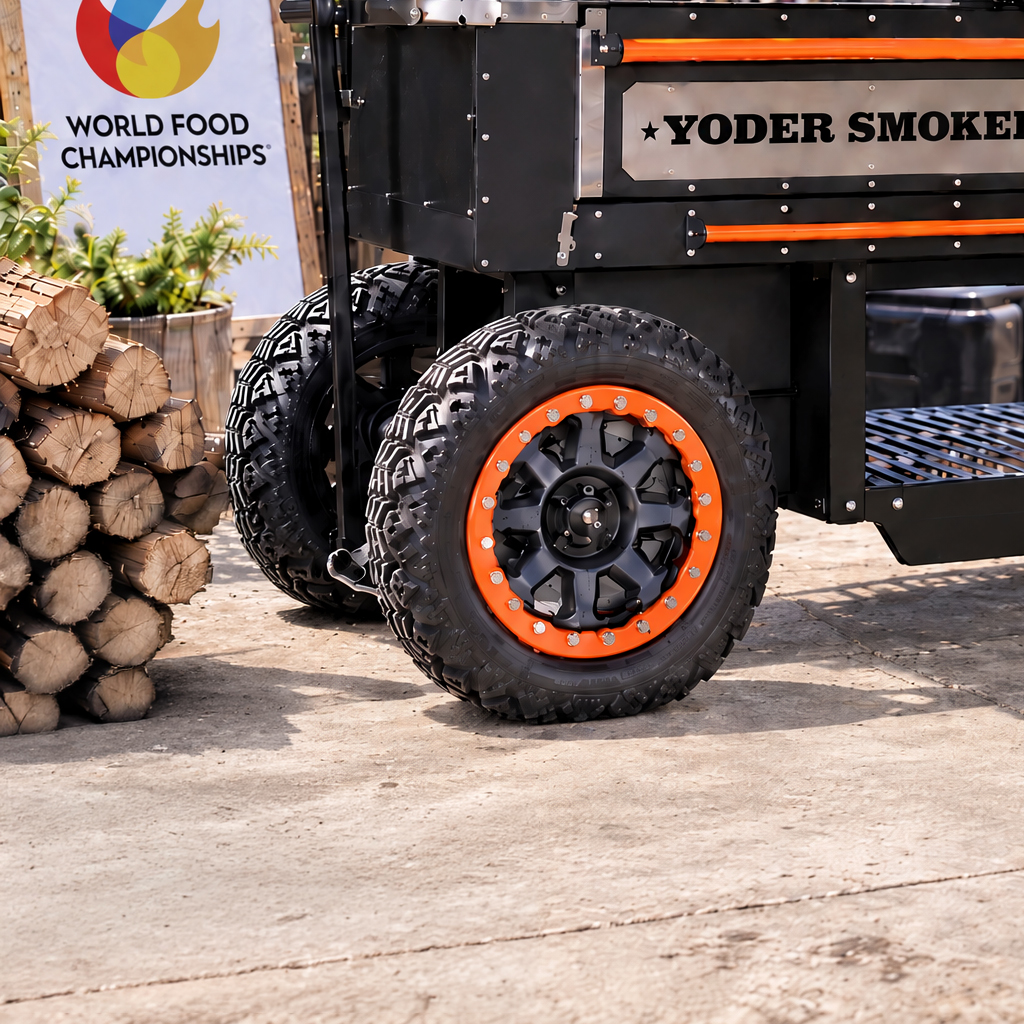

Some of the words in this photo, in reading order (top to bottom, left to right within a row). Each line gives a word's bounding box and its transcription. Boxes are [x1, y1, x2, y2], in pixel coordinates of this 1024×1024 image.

[65, 113, 164, 138] WORLD
[170, 112, 250, 136] FOOD
[663, 112, 836, 146] YODER
